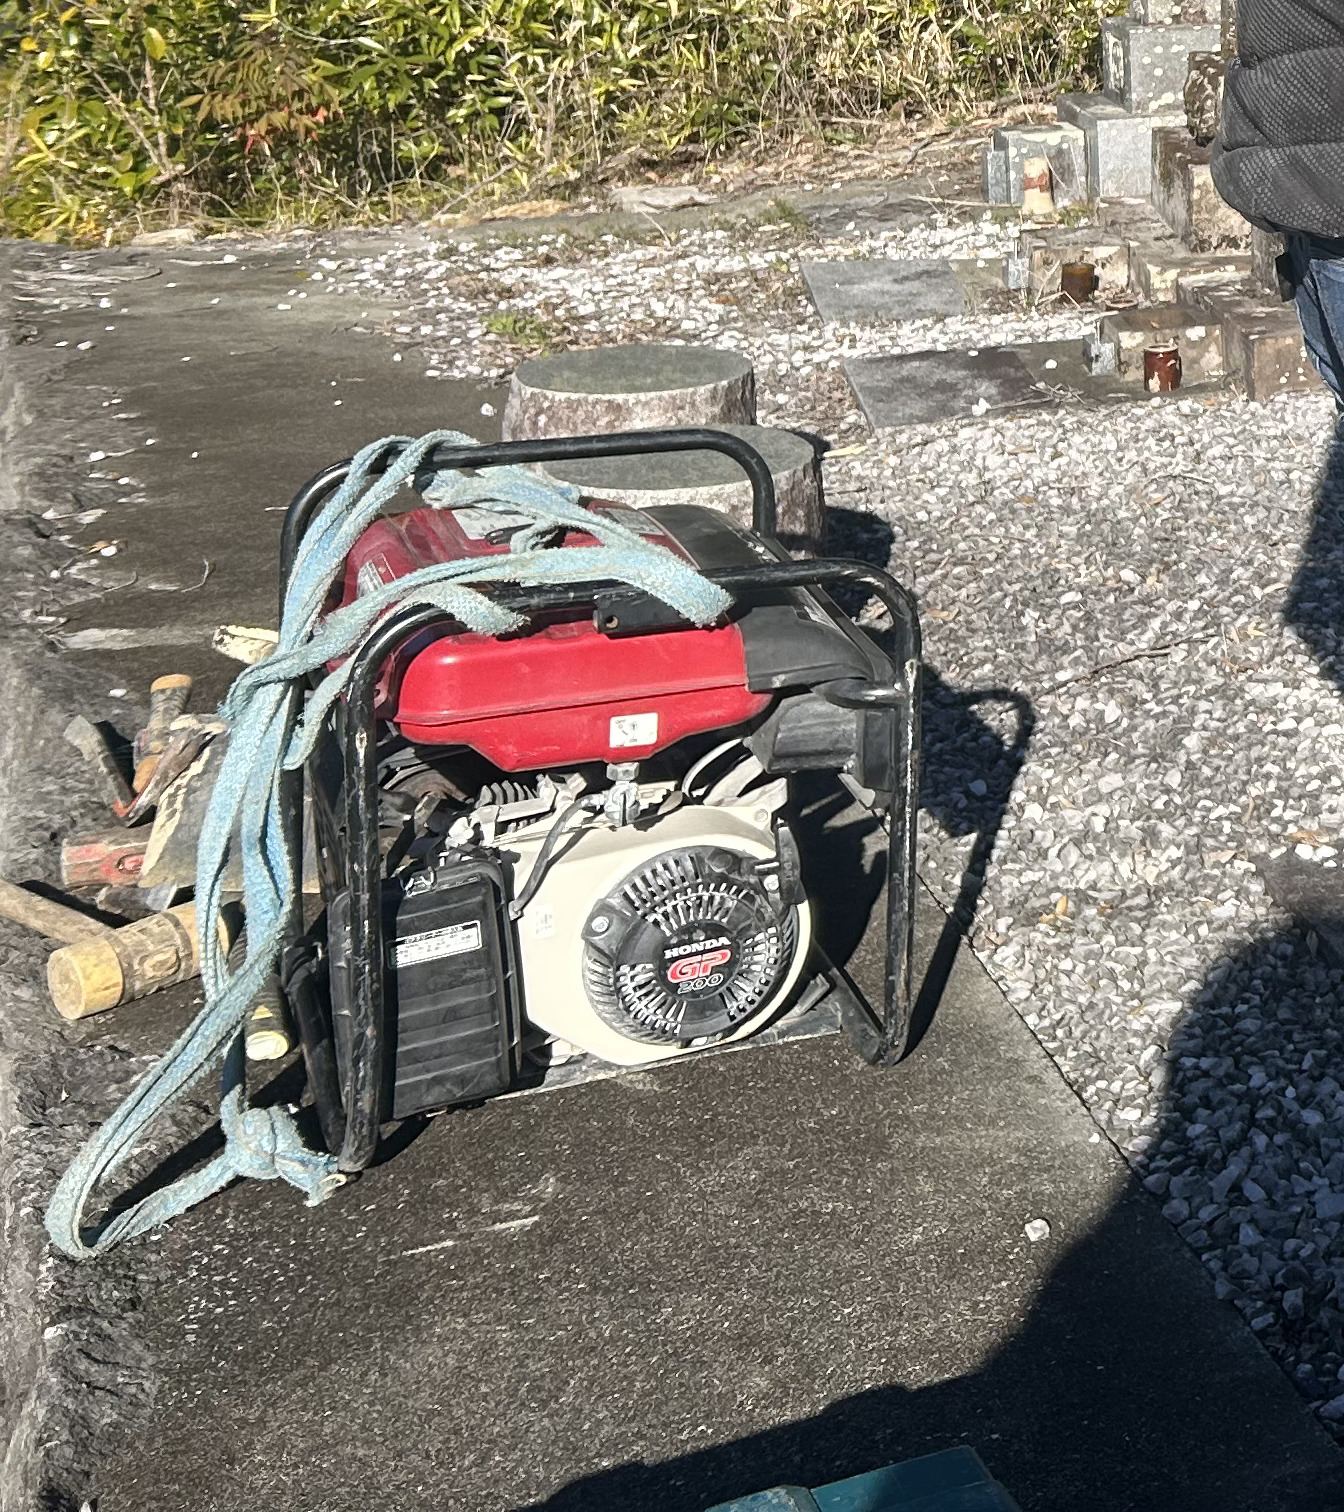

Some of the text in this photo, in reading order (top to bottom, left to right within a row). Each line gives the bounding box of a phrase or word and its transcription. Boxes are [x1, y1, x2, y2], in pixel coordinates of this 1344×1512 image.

[663, 937, 731, 959] HONDA
[667, 949, 731, 983] GP
[677, 973, 723, 994] 200
